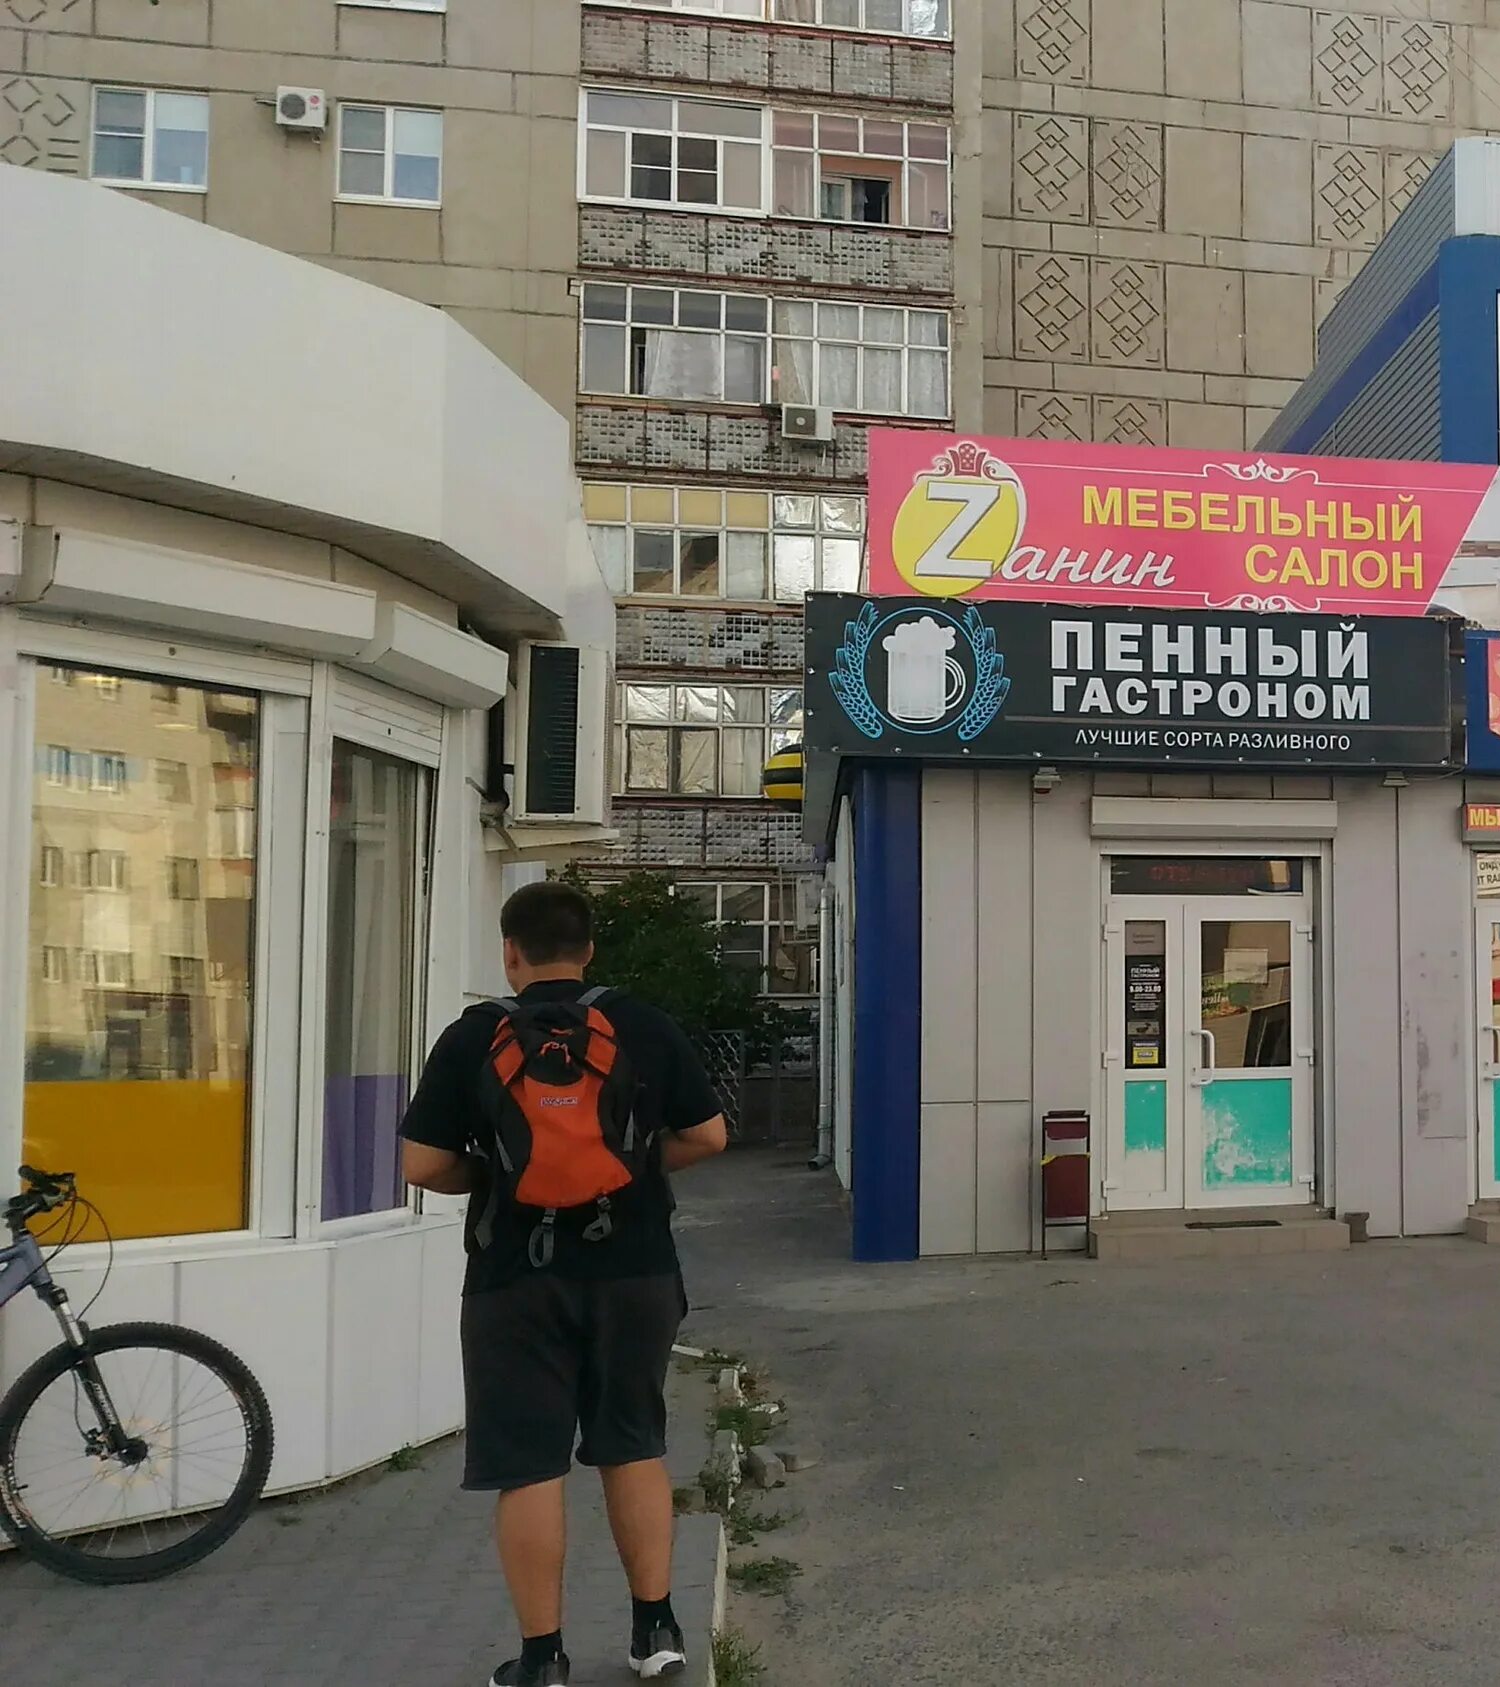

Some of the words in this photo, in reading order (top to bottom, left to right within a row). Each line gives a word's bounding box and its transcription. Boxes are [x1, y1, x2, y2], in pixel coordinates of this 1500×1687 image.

[1082, 485, 1423, 542] МЕБЕЛЬНЫЙ
[1244, 543, 1424, 590] САЛОН
[1050, 619, 1370, 680] ПЕННЫЙ
[1051, 674, 1371, 721] ГАСТРОНОМ
[1075, 728, 1159, 748] ЛУЧШИЕ
[1163, 729, 1224, 749] СОРТА
[1228, 731, 1352, 752] РАЗЛИВНОГО
[1469, 808, 1500, 826] МЫ
